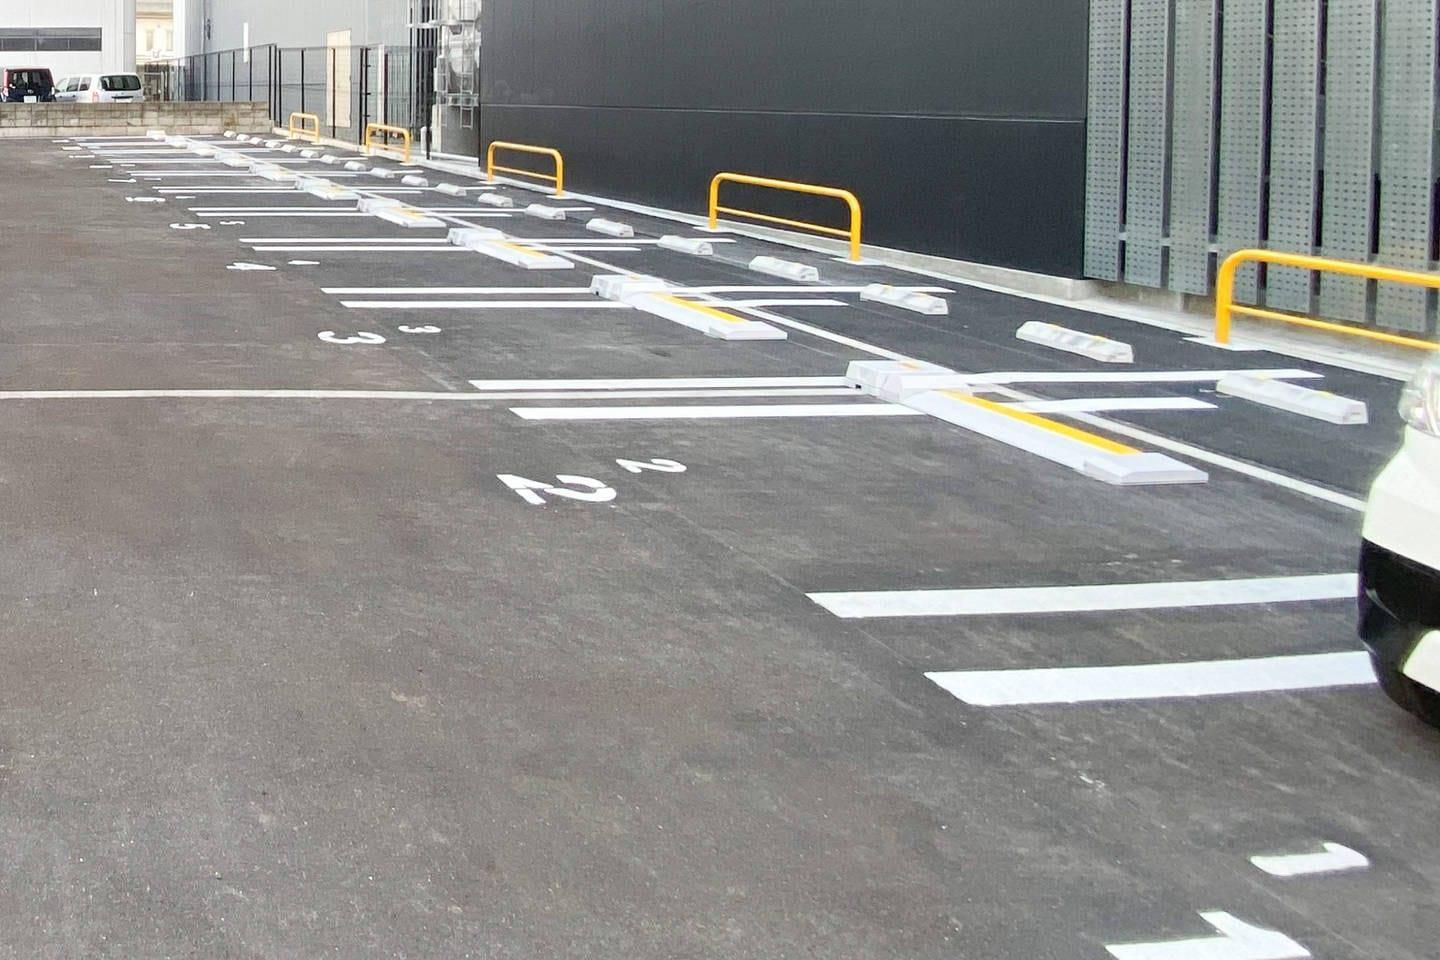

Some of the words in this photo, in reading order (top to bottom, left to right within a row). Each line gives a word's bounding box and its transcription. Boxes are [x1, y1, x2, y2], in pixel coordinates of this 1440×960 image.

[317, 330, 387, 345] 3
[398, 325, 442, 334] 3
[615, 458, 688, 473] 2
[496, 474, 617, 505] 2
[1249, 842, 1369, 876] 1
[1104, 910, 1311, 960] 1
